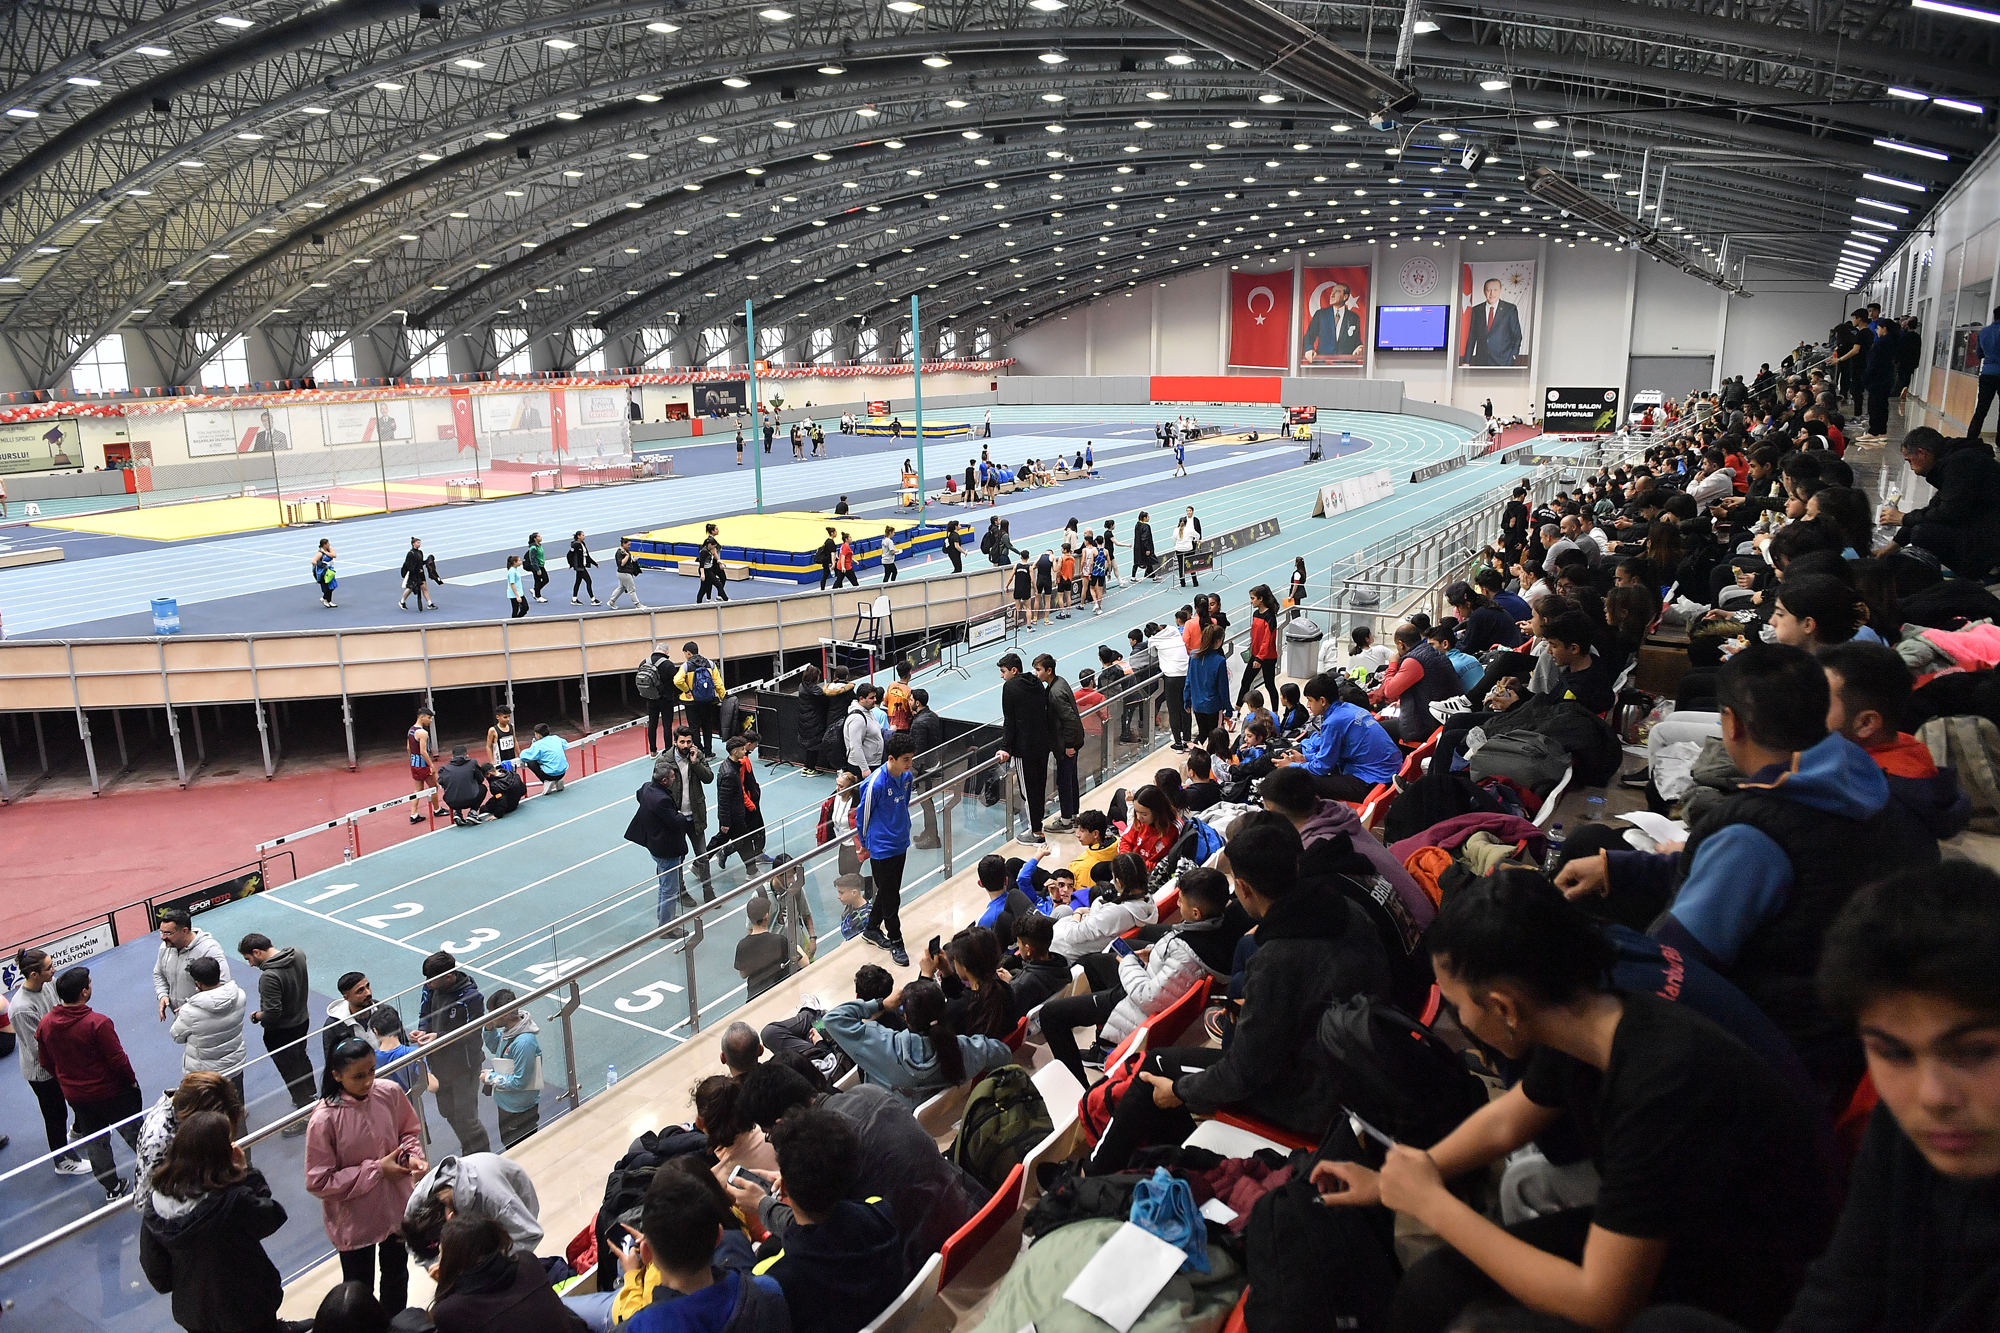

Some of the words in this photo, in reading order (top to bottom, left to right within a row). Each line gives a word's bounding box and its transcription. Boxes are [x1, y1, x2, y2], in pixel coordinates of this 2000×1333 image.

[382, 799, 403, 809] CROWN
[303, 883, 360, 905] 1
[356, 902, 425, 929] 2
[50, 947, 68, 960] KİYE
[70, 937, 99, 953] ESKRİM
[440, 927, 501, 954] 3
[53, 948, 94, 967] ERASYONU
[523, 956, 589, 984] 4
[614, 980, 685, 1013] 5
